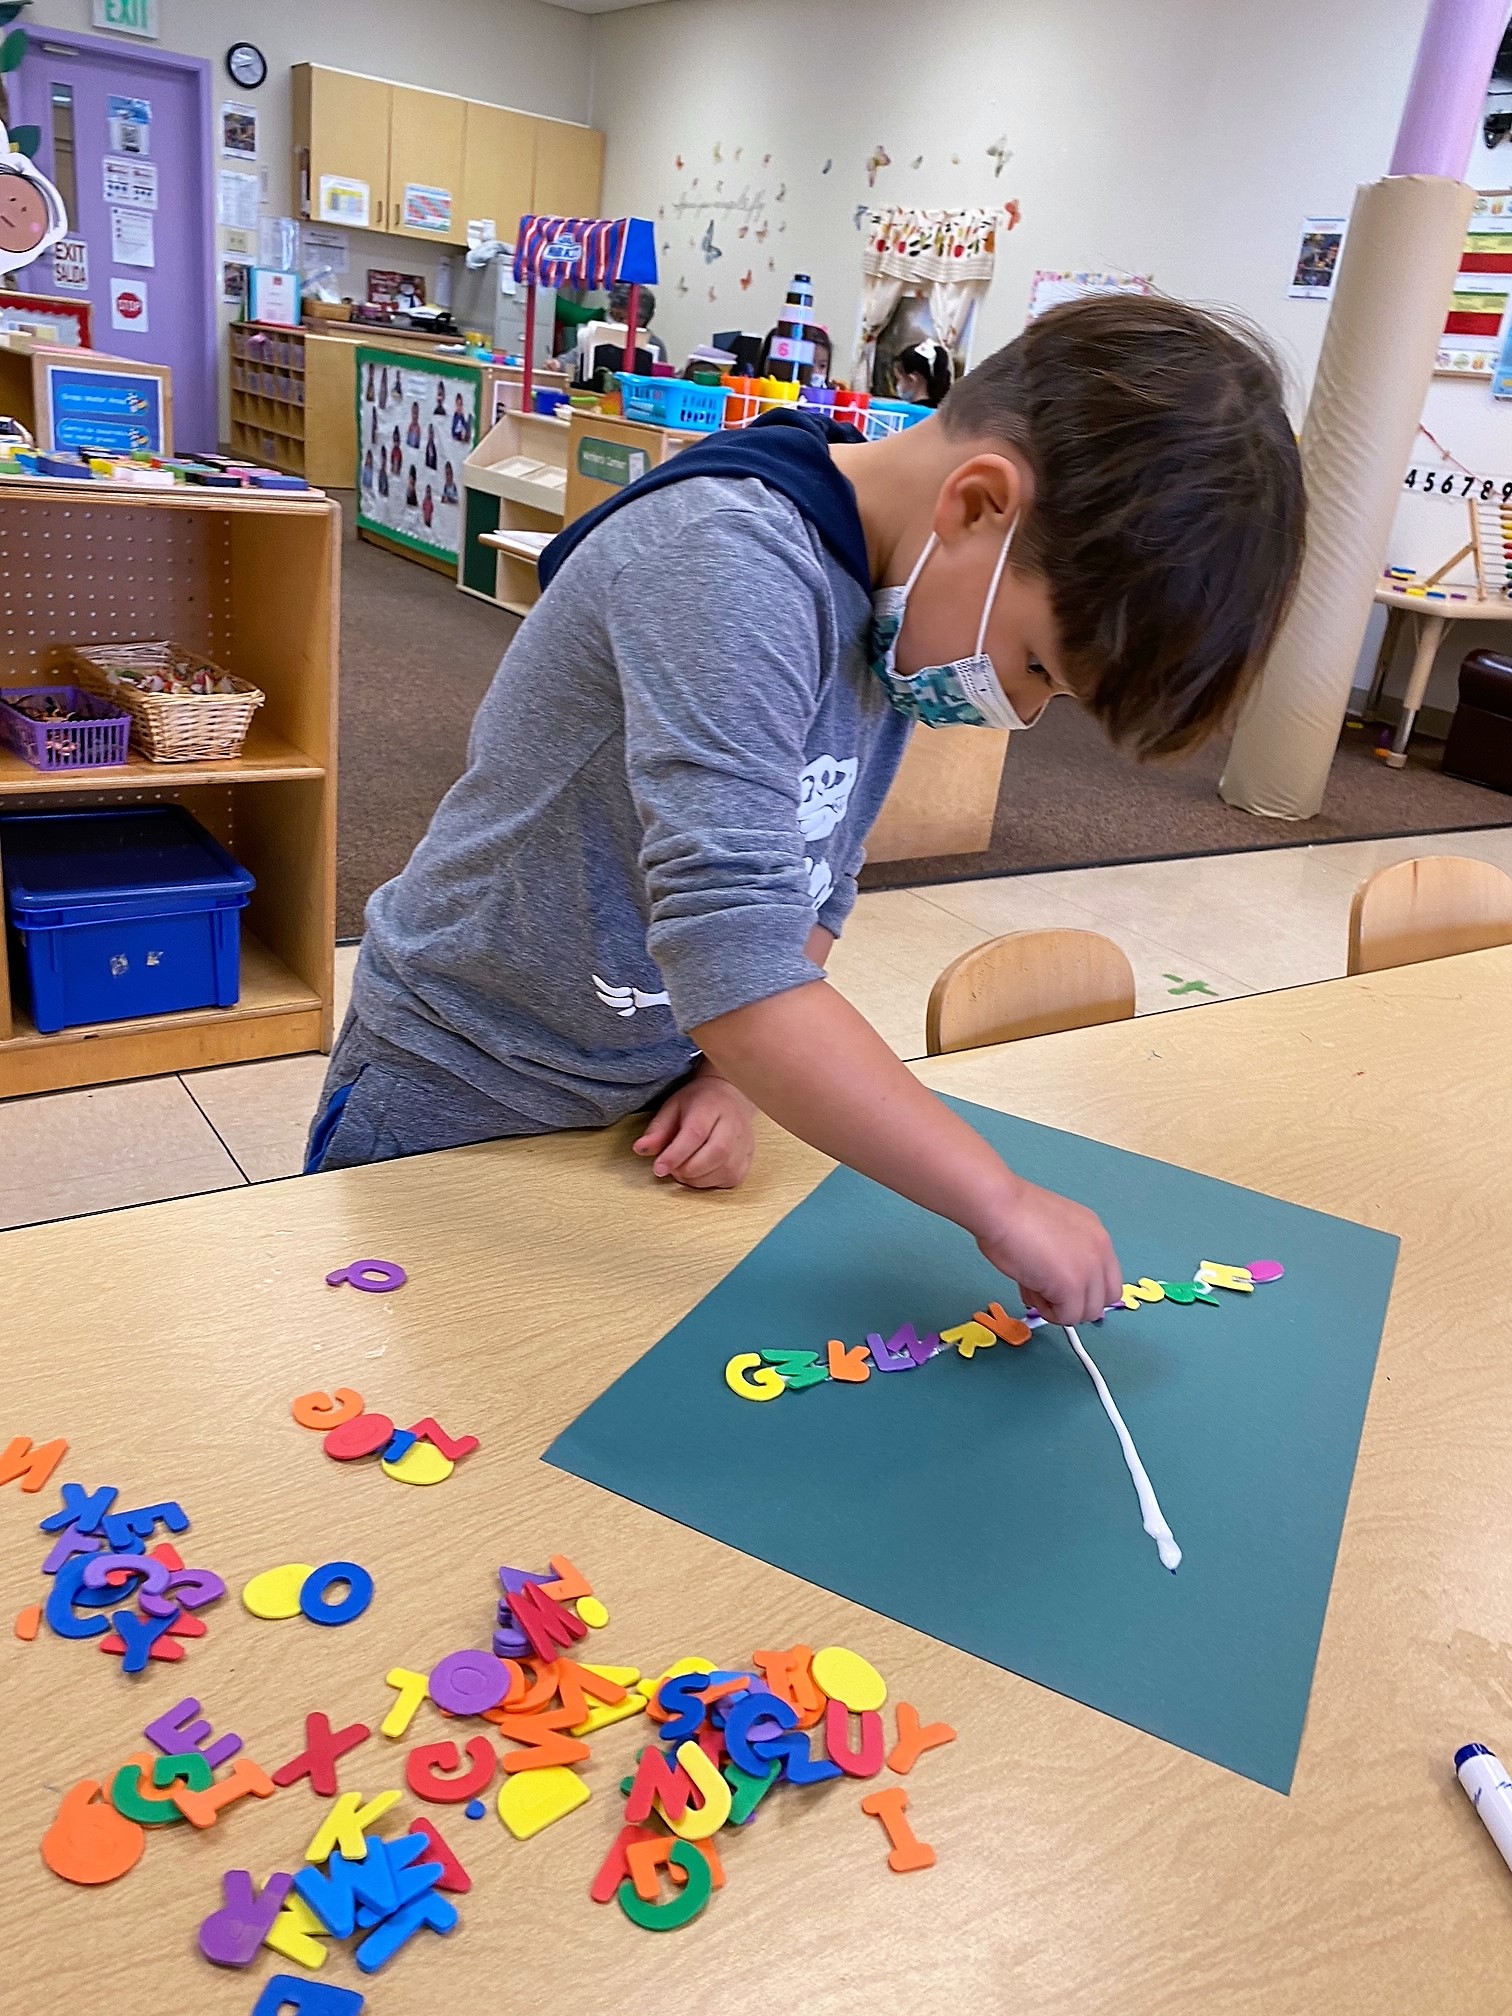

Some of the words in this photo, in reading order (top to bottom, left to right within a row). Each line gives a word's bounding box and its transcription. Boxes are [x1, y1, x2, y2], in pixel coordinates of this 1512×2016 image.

[55, 241, 85, 263] EXIT
[118, 299, 141, 312] STOP
[1404, 469, 1417, 488] 4
[1423, 472, 1436, 492] 5
[1441, 475, 1454, 494] 6
[1460, 476, 1475, 497] 7
[1480, 480, 1493, 500] 8
[725, 1352, 786, 1401] G
[866, 1333, 917, 1373] L
[301, 1562, 374, 1627] O
[112, 1610, 180, 1673] Y
[144, 1697, 243, 1771] E
[658, 1673, 711, 1741] S
[826, 1699, 884, 1778] U
[887, 1701, 957, 1775] Y
[272, 1711, 372, 1797] X
[304, 1790, 403, 1864] K
[861, 1787, 937, 1873] I
